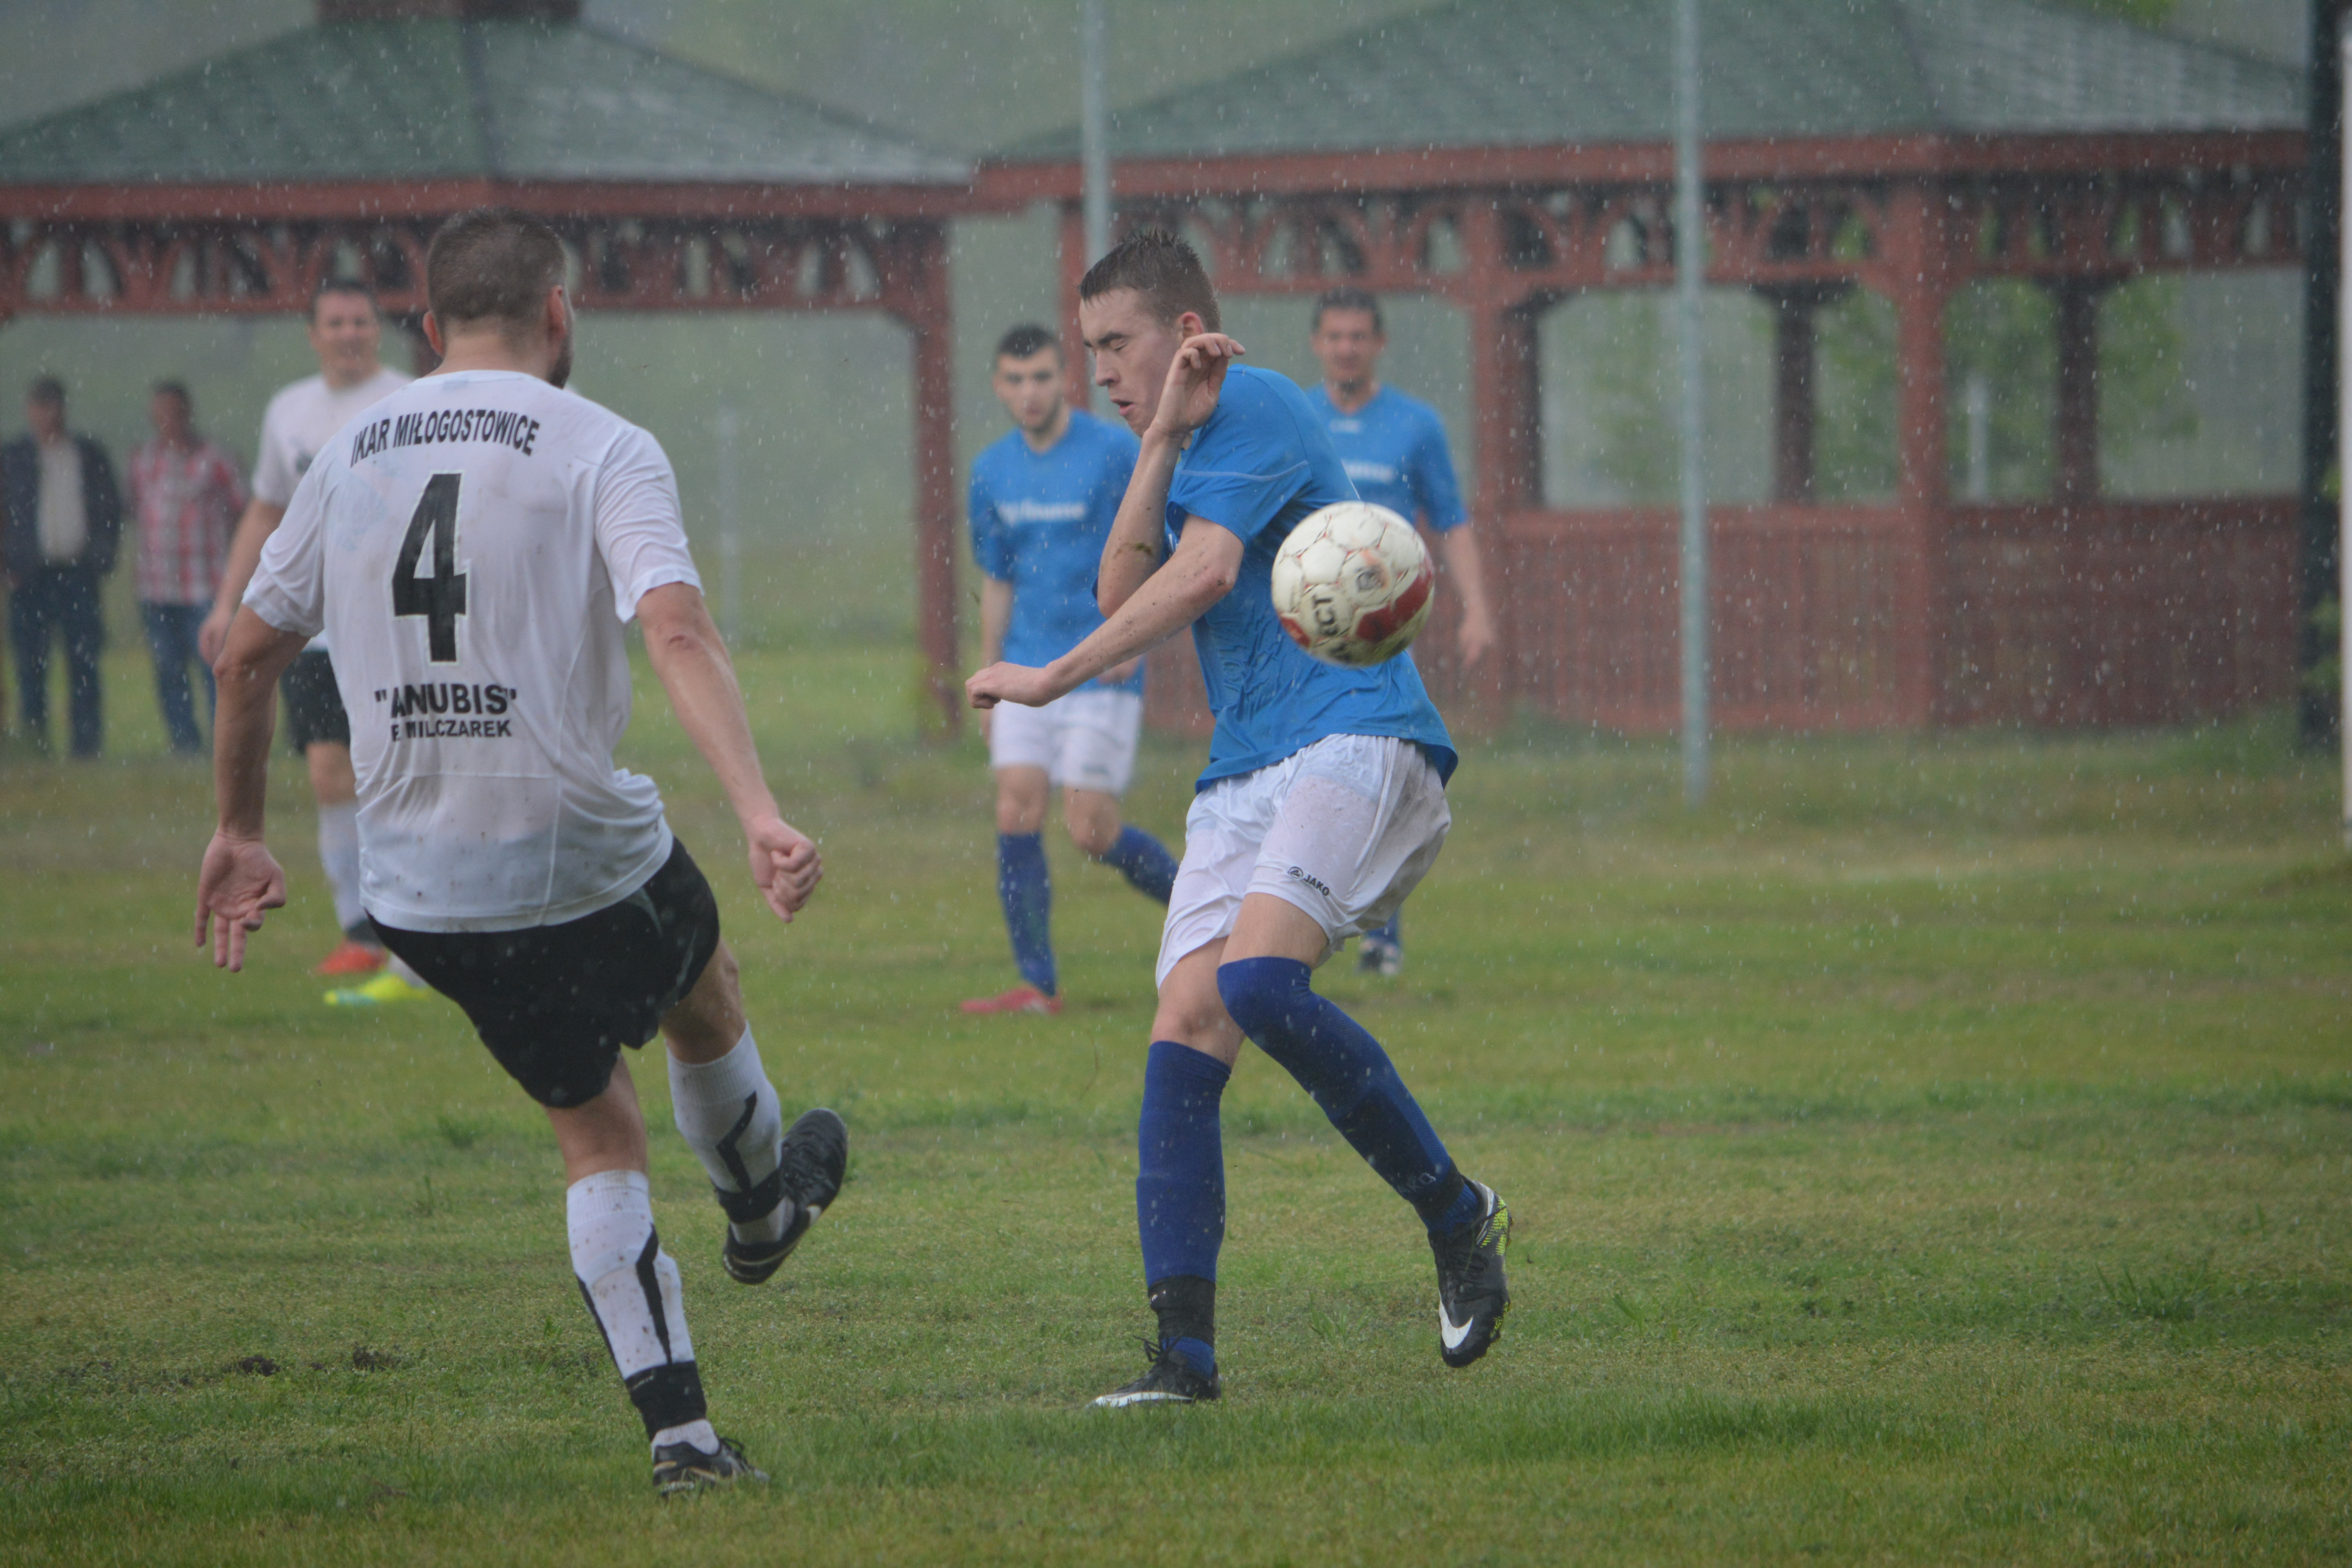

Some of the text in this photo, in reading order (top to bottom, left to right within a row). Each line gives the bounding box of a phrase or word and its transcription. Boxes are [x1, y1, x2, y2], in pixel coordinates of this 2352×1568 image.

[350, 409, 540, 468] IKAR MIŁOGOSTOWICE
[391, 472, 468, 663] 4
[1304, 875, 1330, 897] JAKO
[1396, 1172, 1437, 1194] AKO
